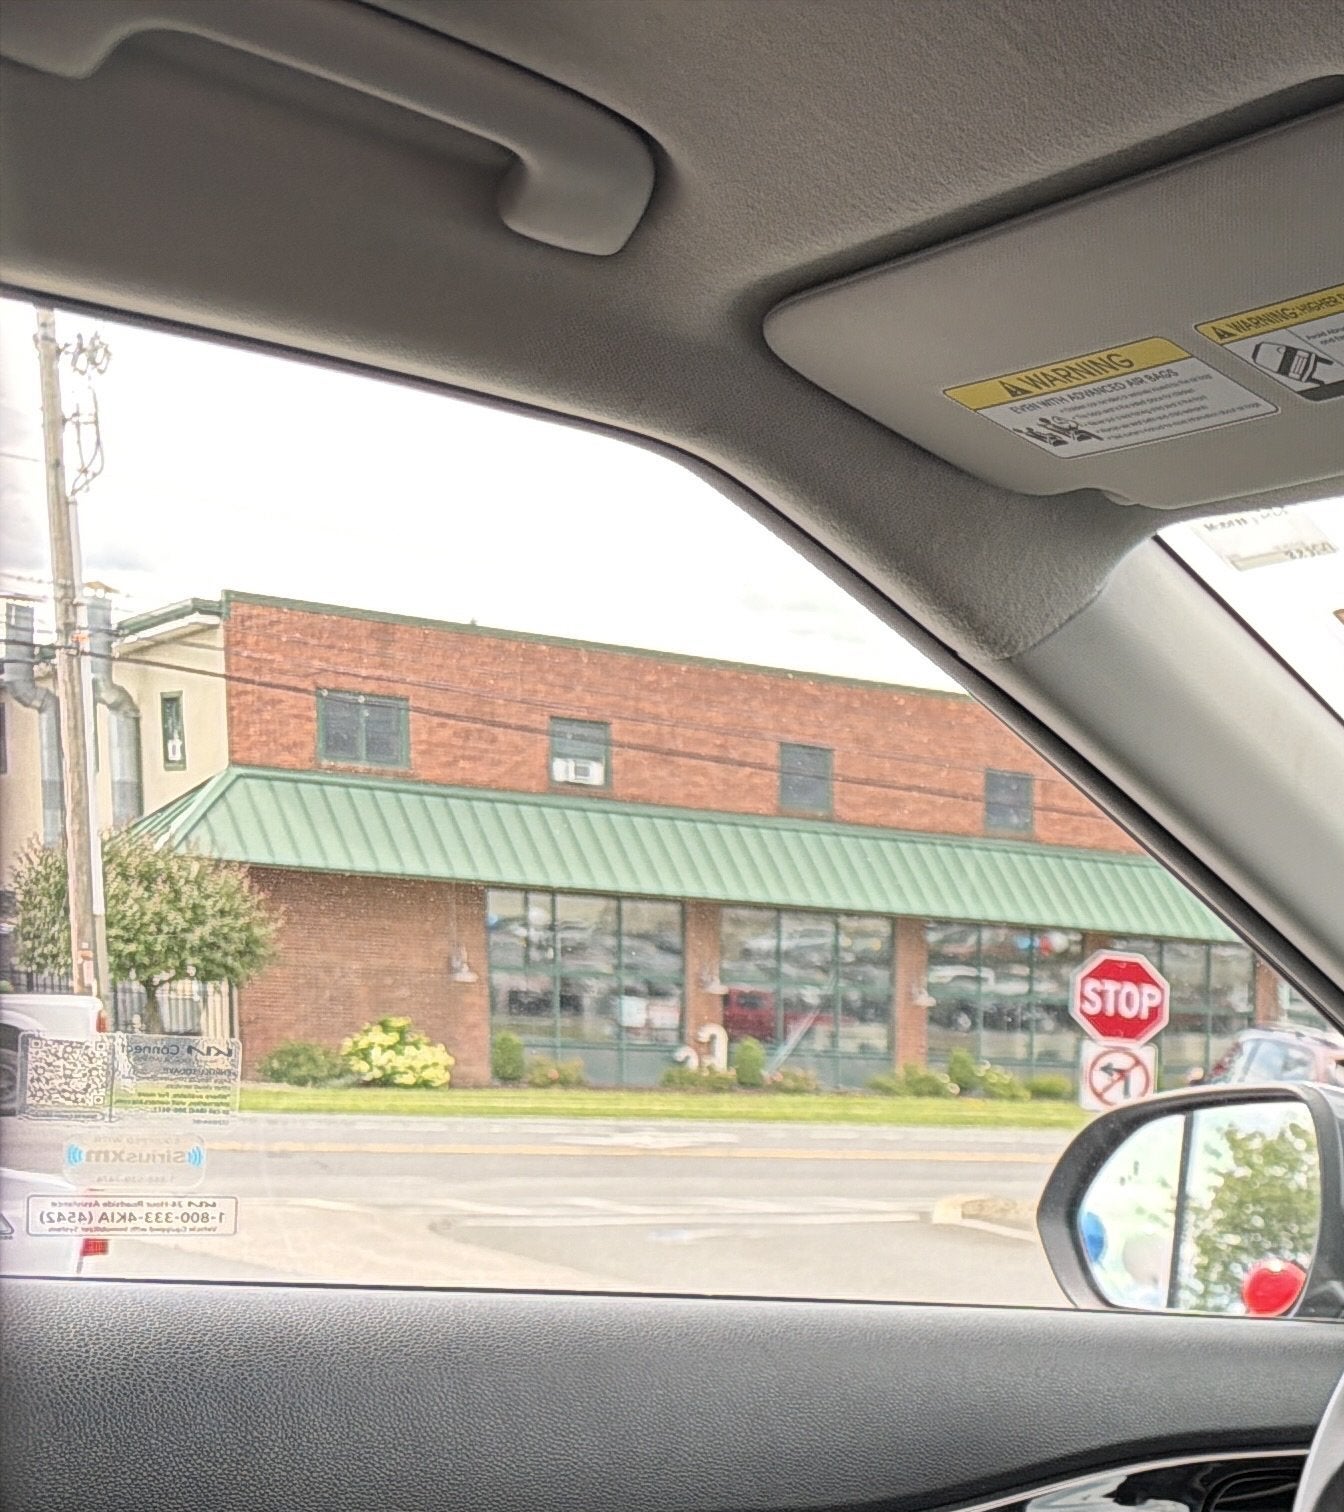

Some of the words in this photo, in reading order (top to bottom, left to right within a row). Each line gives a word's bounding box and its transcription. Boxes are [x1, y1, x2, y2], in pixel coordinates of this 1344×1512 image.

[1293, 295, 1344, 315] HIGHER
[1006, 401, 1043, 415] EVEN
[1034, 395, 1071, 408] WITH
[1061, 380, 1130, 402] ADVANCED
[1121, 375, 1150, 387] AIR
[1140, 367, 1182, 382] BAGS
[1013, 350, 1141, 392] WARNING
[1081, 978, 1162, 1020] STOP
